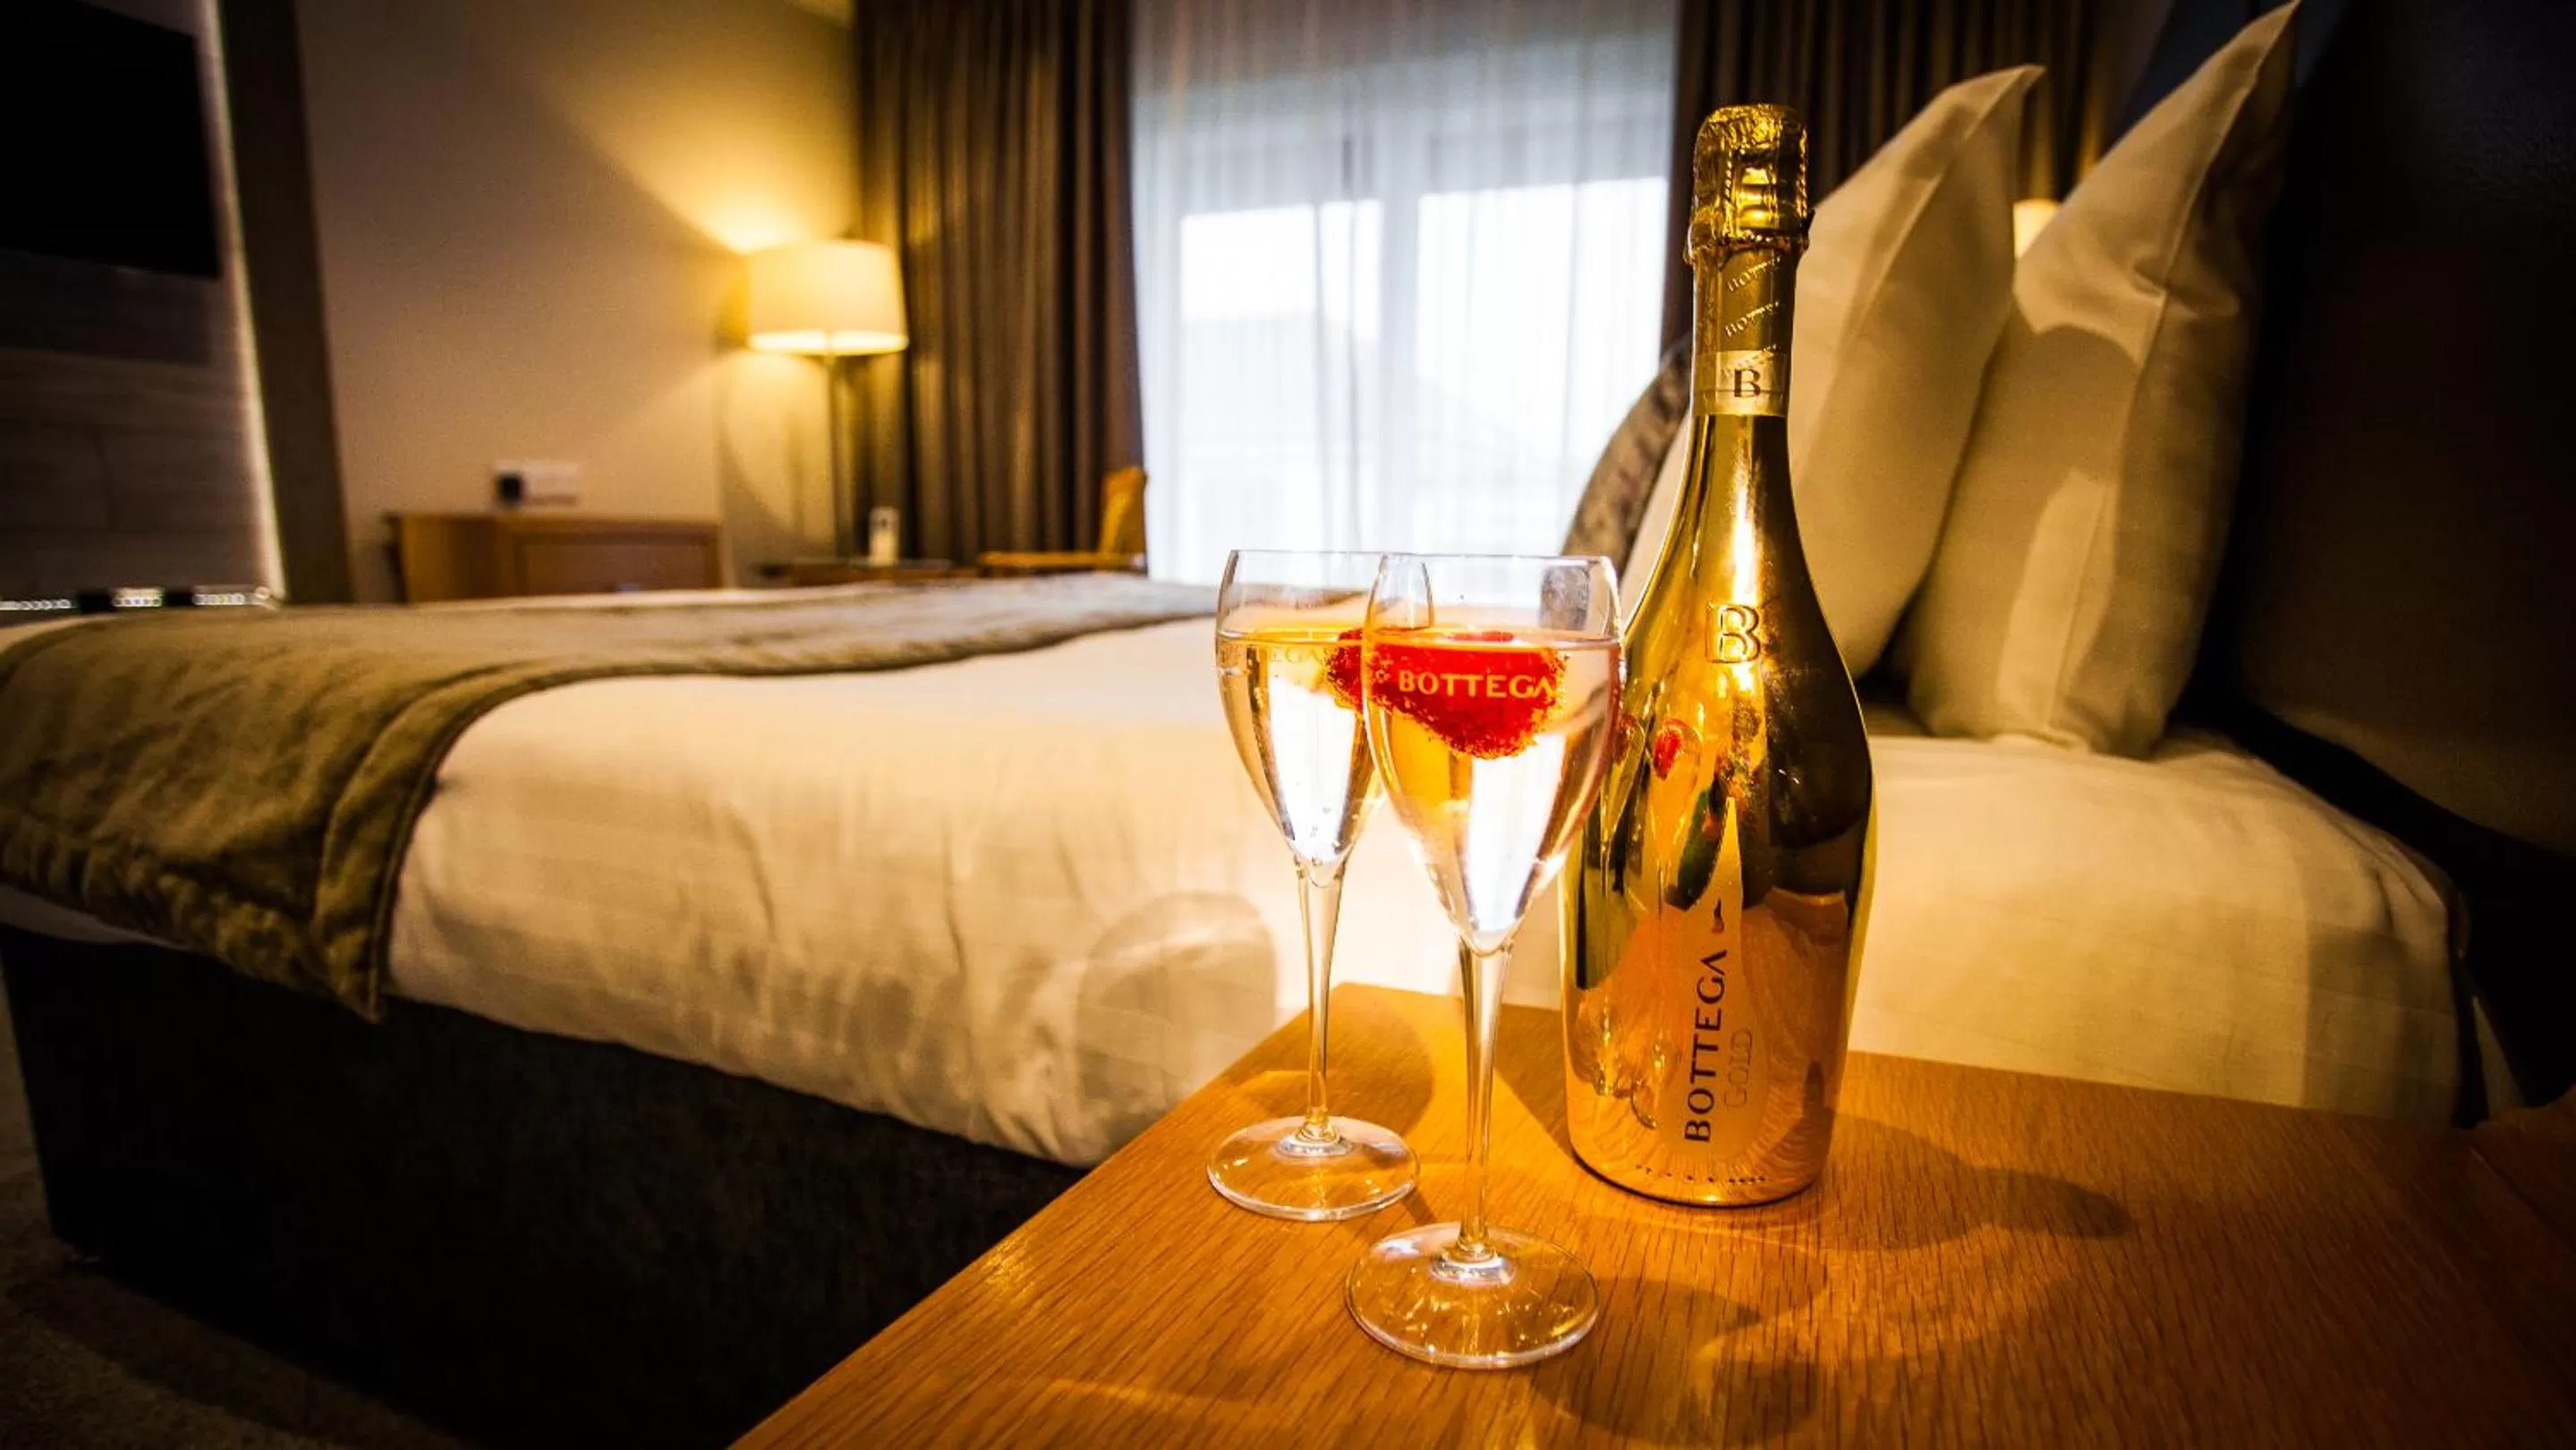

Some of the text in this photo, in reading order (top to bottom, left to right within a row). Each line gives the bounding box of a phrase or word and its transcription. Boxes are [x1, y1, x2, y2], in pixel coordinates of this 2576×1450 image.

[1734, 368, 1761, 397] B
[1705, 603, 1760, 663] B
[1399, 670, 1558, 698] BOTTEGA
[1684, 950, 1728, 1142] BOTTEGA
[1724, 1028, 1752, 1108] GOLD
